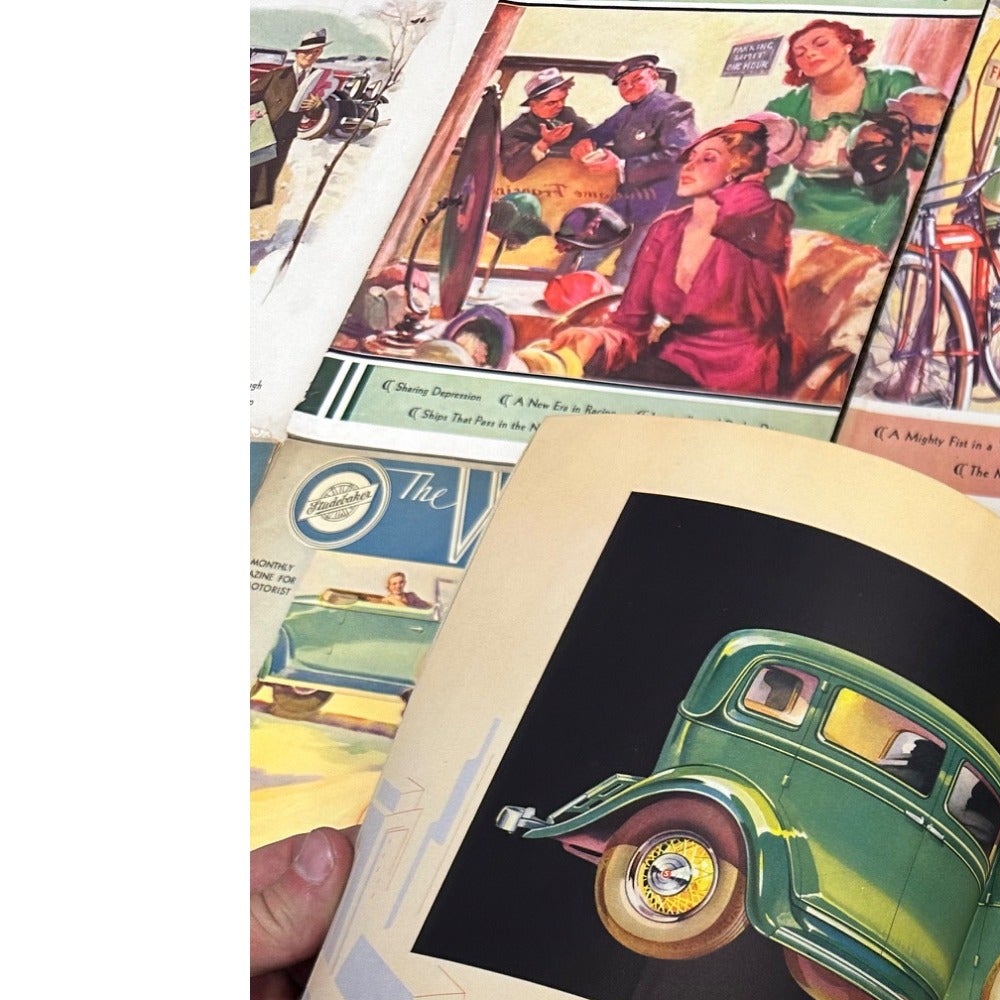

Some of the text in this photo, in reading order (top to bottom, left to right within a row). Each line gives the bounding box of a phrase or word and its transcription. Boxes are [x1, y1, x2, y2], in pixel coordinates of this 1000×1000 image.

[395, 382, 428, 397] Sharing
[432, 386, 482, 402] Depression
[513, 396, 524, 407] A
[528, 399, 550, 410] New
[553, 401, 569, 412] Era
[572, 405, 581, 413] in
[421, 409, 448, 423] Ships
[451, 413, 473, 426] That
[475, 416, 495, 428] Pass
[499, 419, 508, 430] in
[511, 421, 526, 432] the
[887, 430, 900, 441] A
[904, 432, 945, 449] Mighty
[949, 436, 968, 449] Fist
[972, 440, 983, 450] in
[986, 444, 993, 452] a
[969, 465, 990, 479] The
[306, 491, 373, 515] Studebaker
[250, 582, 292, 595] OTORIST
[277, 574, 297, 585] FOR
